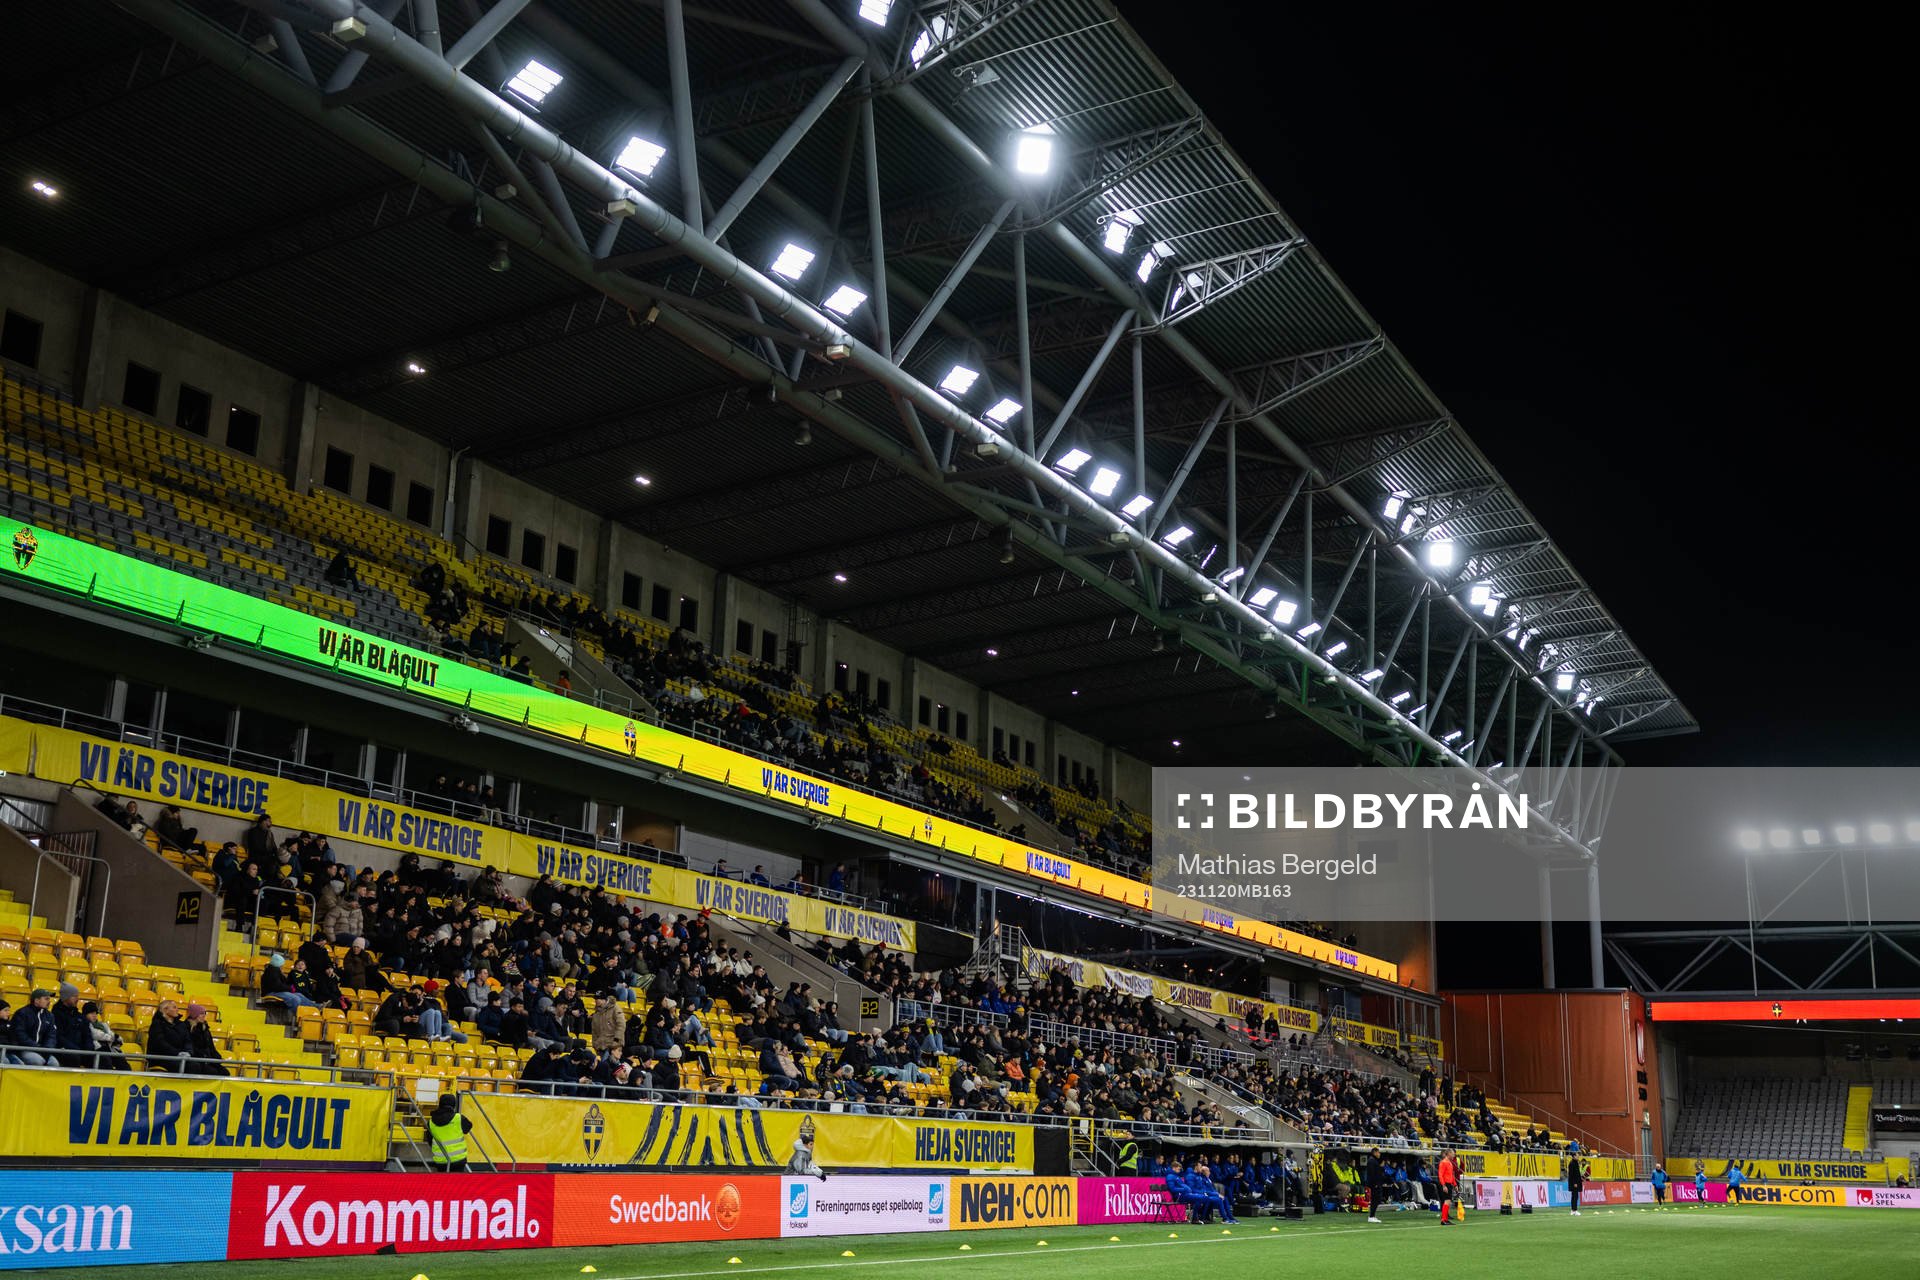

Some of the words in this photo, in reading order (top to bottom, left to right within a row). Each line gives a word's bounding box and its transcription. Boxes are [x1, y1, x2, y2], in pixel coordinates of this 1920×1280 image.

[319, 627, 338, 657] VI
[340, 633, 365, 666] ÄR
[367, 642, 439, 687] BLÅGULT
[80, 741, 110, 783] VI
[114, 747, 155, 792] ÄR
[159, 760, 269, 814] SVERIGE
[762, 768, 772, 790] VI
[774, 770, 788, 794] ÄR
[790, 776, 830, 806] SVERIGE
[338, 798, 361, 835] VI
[363, 802, 396, 841] ÄR
[398, 813, 483, 860] SVERIGE
[537, 844, 555, 876] VI
[558, 847, 583, 881] ÄR
[585, 854, 652, 895] SVERIGE
[177, 897, 200, 919] A2
[696, 877, 710, 906] VI
[712, 881, 733, 912] ÄR
[735, 886, 789, 924] SVERIGE
[825, 906, 837, 932] VI
[838, 909, 856, 935] ÄR
[857, 912, 903, 946] SVERIGE
[861, 1001, 879, 1015] B2
[1188, 988, 1212, 1009] SVERIGE
[68, 1084, 115, 1144] VI
[119, 1083, 182, 1146] ÄR
[188, 1088, 351, 1150] BLÅGULT
[915, 1127, 951, 1161] HEJA
[953, 1128, 1015, 1163] SVERIGE!
[1778, 1163, 1791, 1177] VI
[1794, 1162, 1811, 1177] ÄR
[1814, 1164, 1868, 1179] SVERIGE
[609, 1193, 712, 1224] Swedbank
[815, 1199, 870, 1214] Föreningarnas
[871, 1201, 888, 1214] eget
[1104, 1183, 1163, 1217] Folksam
[1875, 1192, 1912, 1200] SVENSKA
